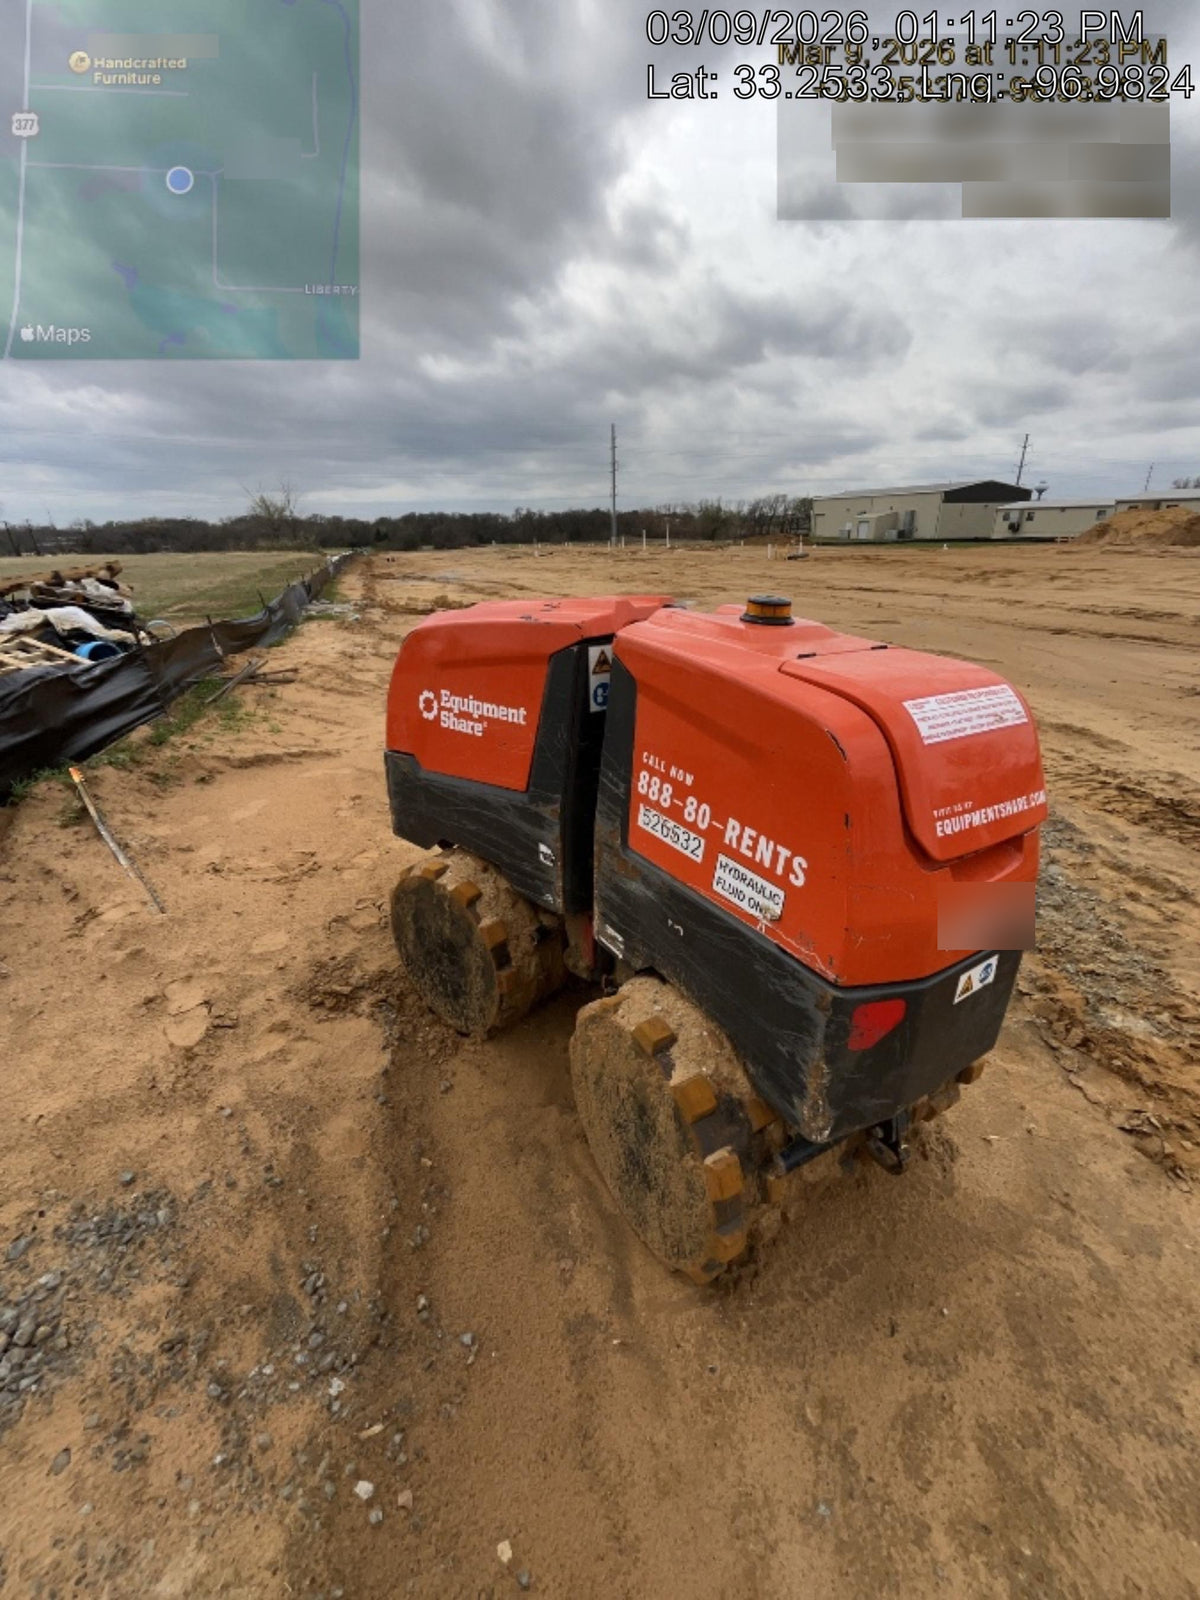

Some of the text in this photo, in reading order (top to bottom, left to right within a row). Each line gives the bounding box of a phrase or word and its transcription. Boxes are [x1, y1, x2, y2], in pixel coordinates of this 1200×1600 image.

[440, 689, 527, 725] Equipment
[642, 751, 694, 787] CALL NOW
[637, 770, 808, 887] 888-80-RENTS
[641, 807, 703, 859] 526532
[935, 789, 1047, 837] EQUIPMENTSHARE.COM
[715, 876, 746, 904] FLUID
[718, 860, 782, 907] HYDRAULIC
